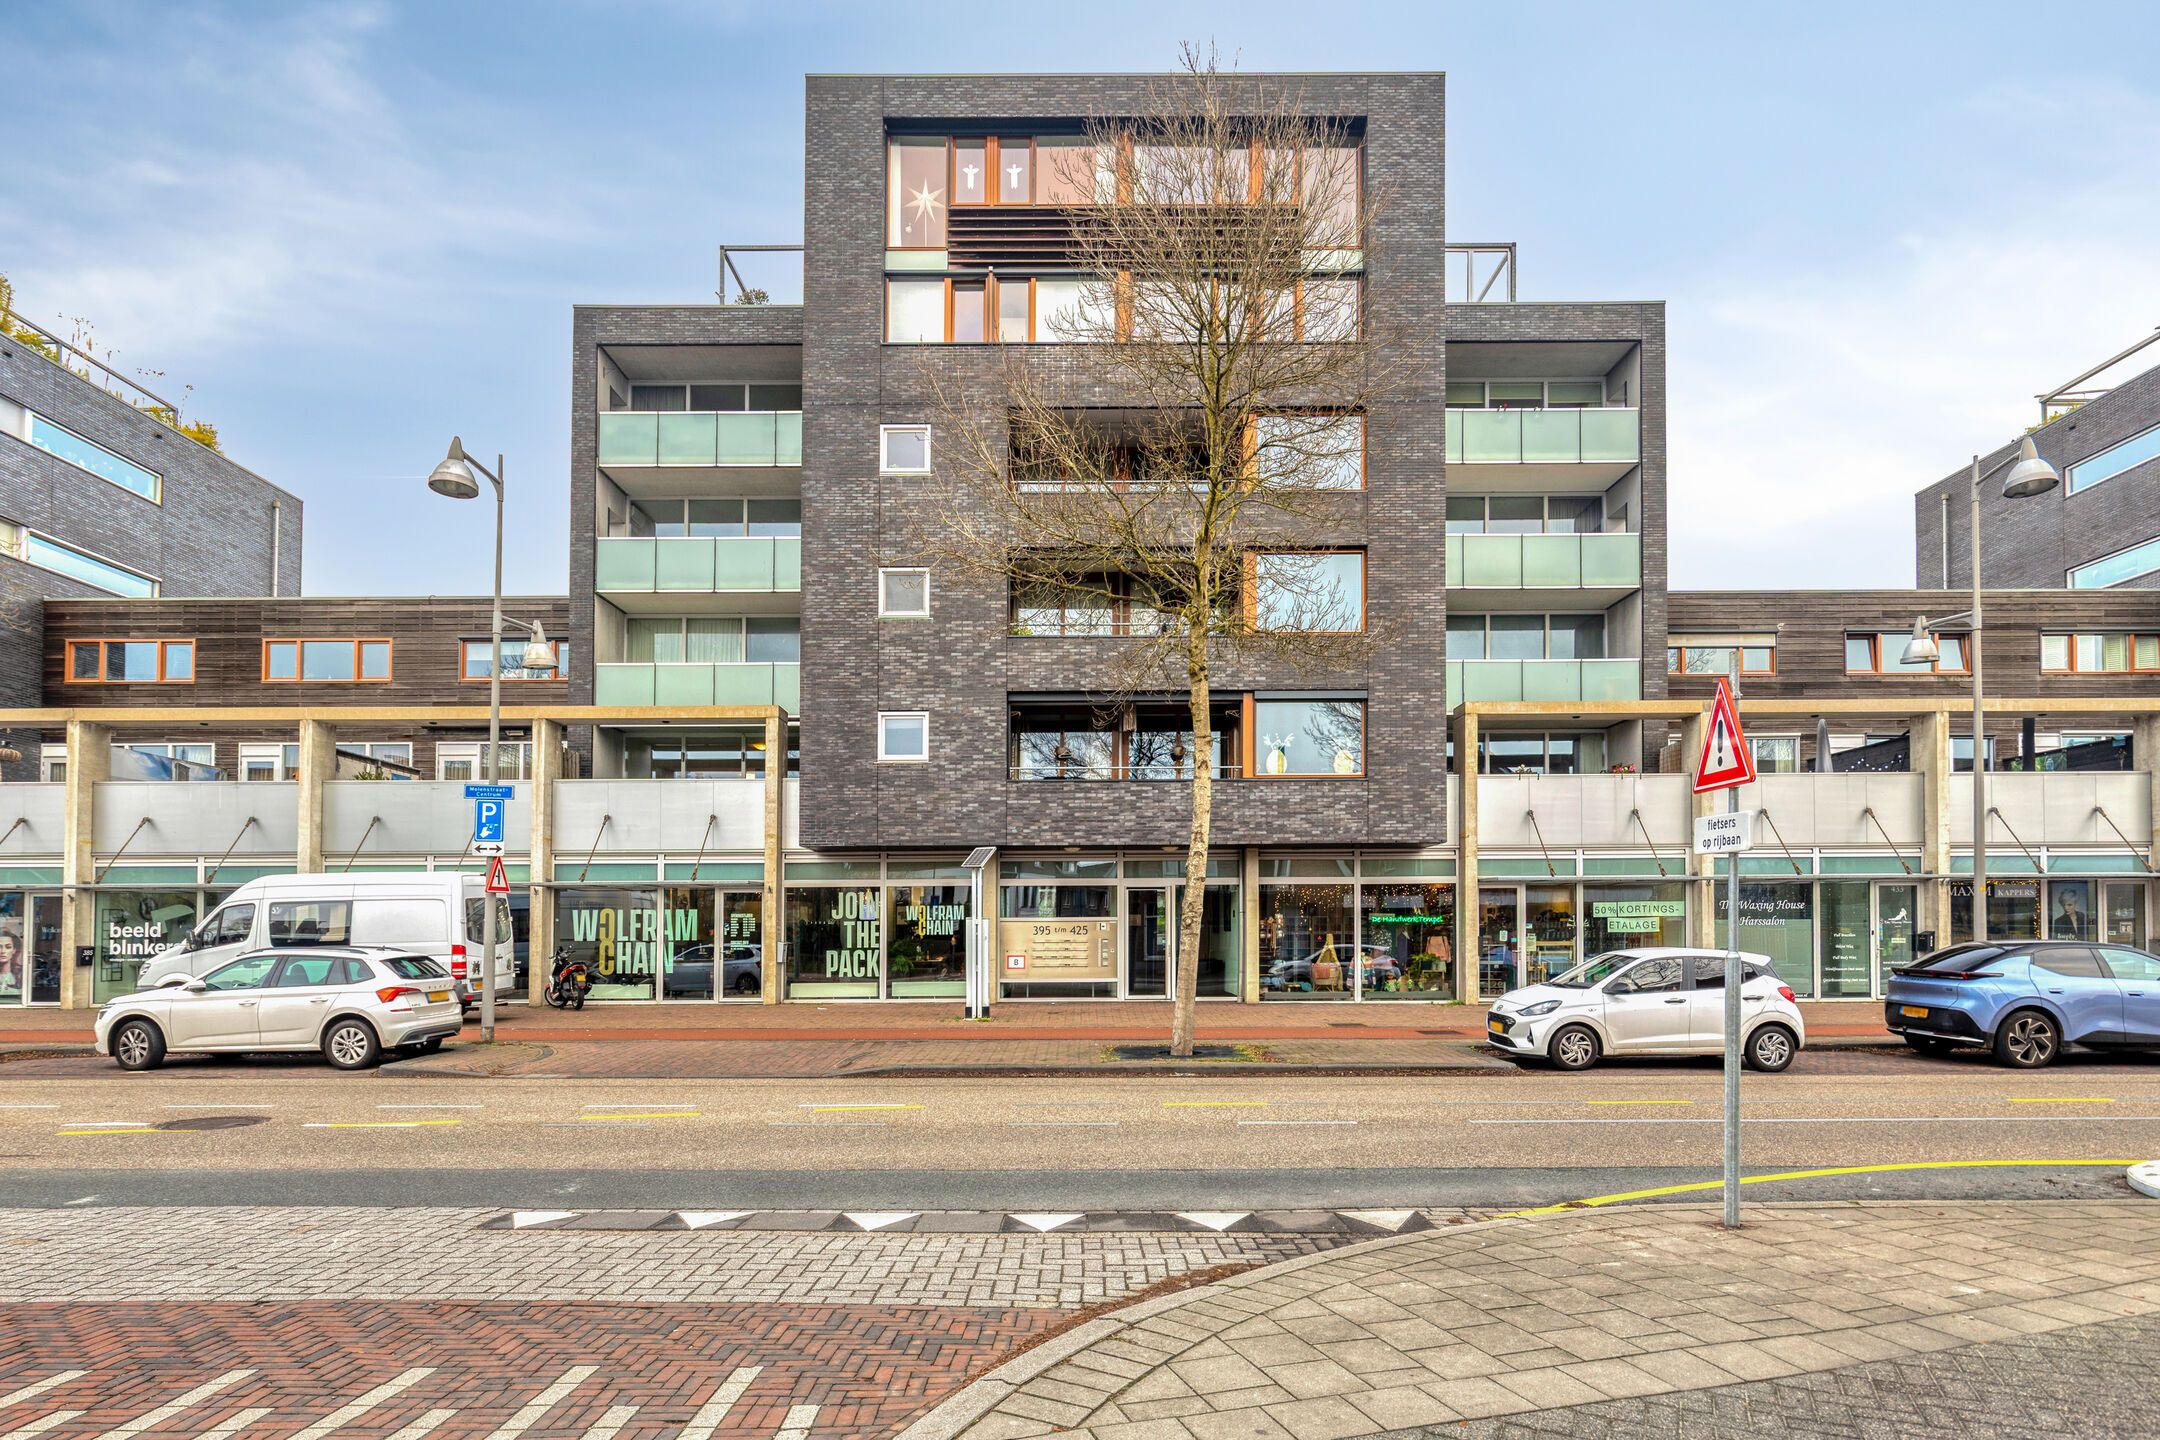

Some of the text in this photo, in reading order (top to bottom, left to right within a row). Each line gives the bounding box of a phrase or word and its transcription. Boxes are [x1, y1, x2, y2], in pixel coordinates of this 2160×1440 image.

[482, 802, 497, 823] P
[1707, 818, 1736, 831] fietsers
[1702, 834, 1741, 850] op rijbaan
[1997, 889, 2036, 897] KAPPERS
[831, 891, 880, 920] JOIN
[905, 904, 965, 921] WOLFRAM
[1594, 904, 1679, 915] 50% KORTINGS-
[1739, 899, 1775, 912] Waxing
[1776, 899, 1806, 910] House
[572, 908, 698, 942] WOLFRAM
[1371, 915, 1381, 923] De
[1608, 920, 1657, 930] ETALAGE
[1739, 915, 1785, 926] Harssalon
[109, 921, 162, 938] beeld
[843, 920, 880, 949] THE
[918, 919, 954, 937] CHAIN
[1032, 925, 1088, 936] 395 t/m 425
[109, 939, 181, 955] blinker
[598, 940, 675, 976] CHAIN
[825, 949, 880, 978] PACK
